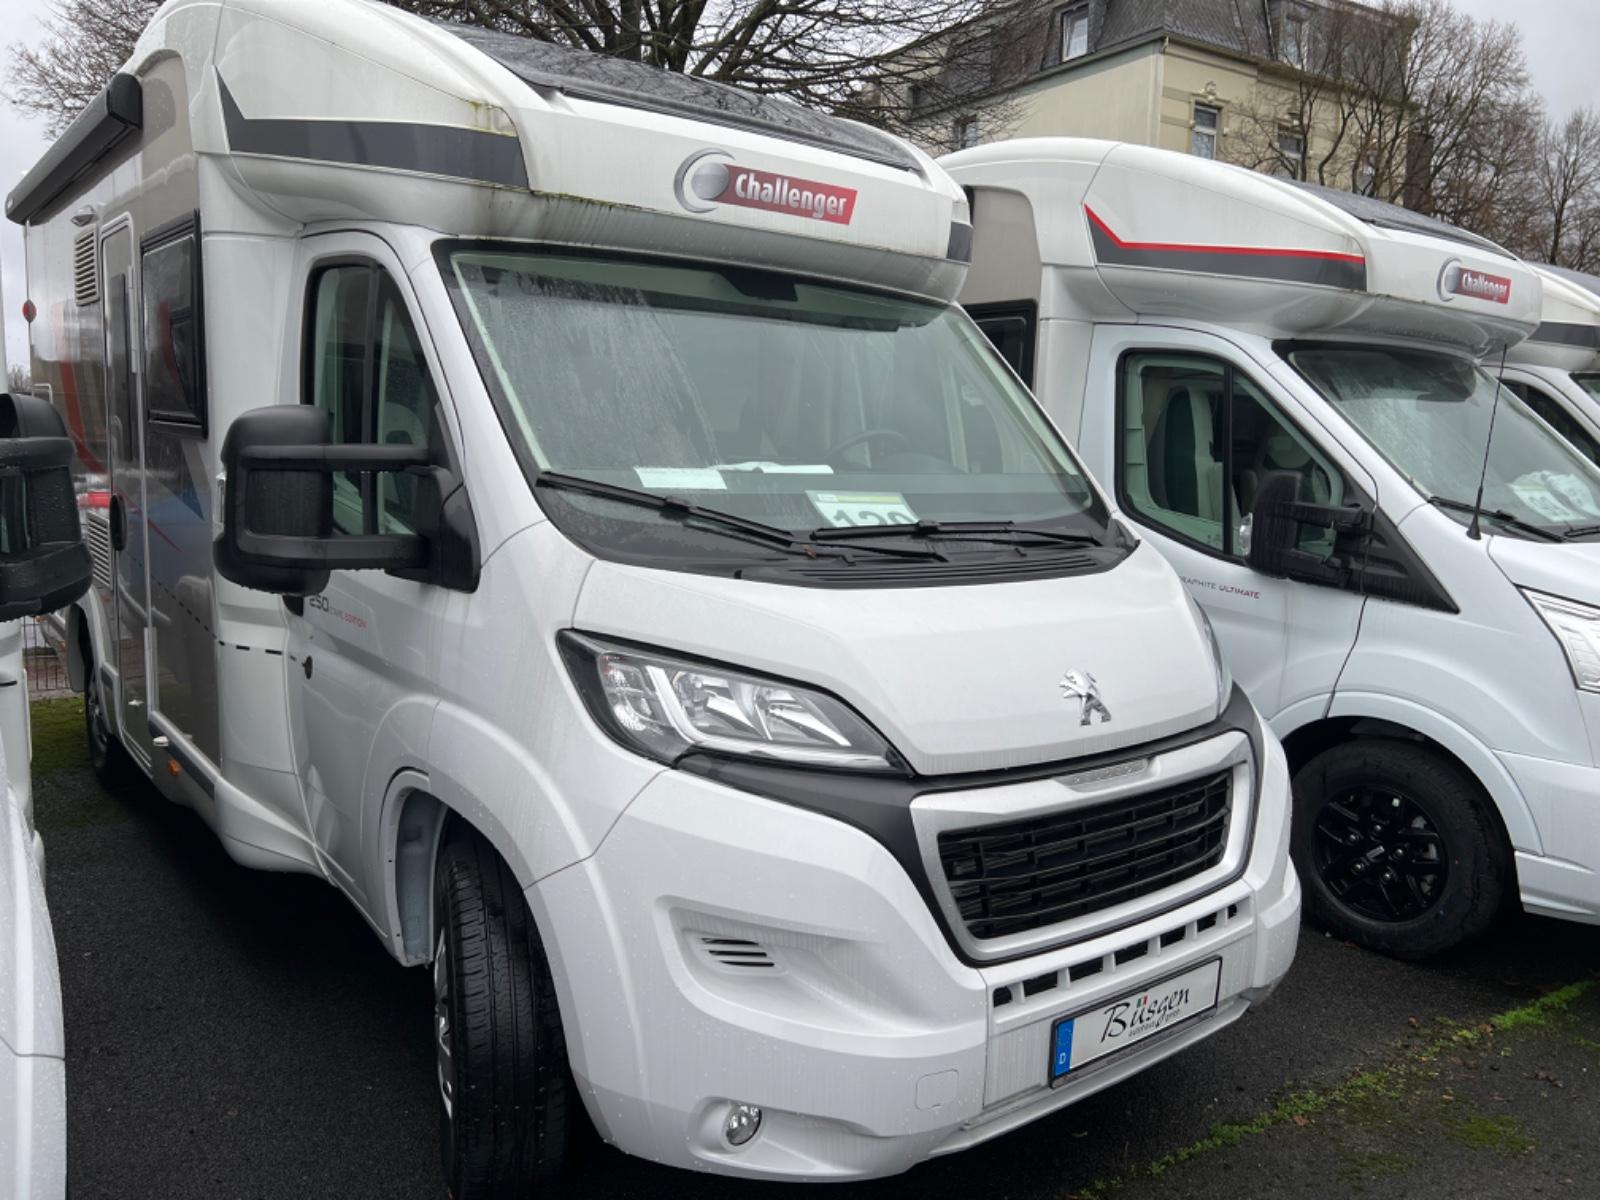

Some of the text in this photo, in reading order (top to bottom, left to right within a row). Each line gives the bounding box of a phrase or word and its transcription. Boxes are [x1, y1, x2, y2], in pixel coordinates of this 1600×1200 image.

[735, 172, 847, 218] Challenger
[1179, 576, 1260, 599] RAPHITE ULTIMATE
[1101, 988, 1189, 1042] Büsgen
[1059, 1052, 1066, 1065] D
